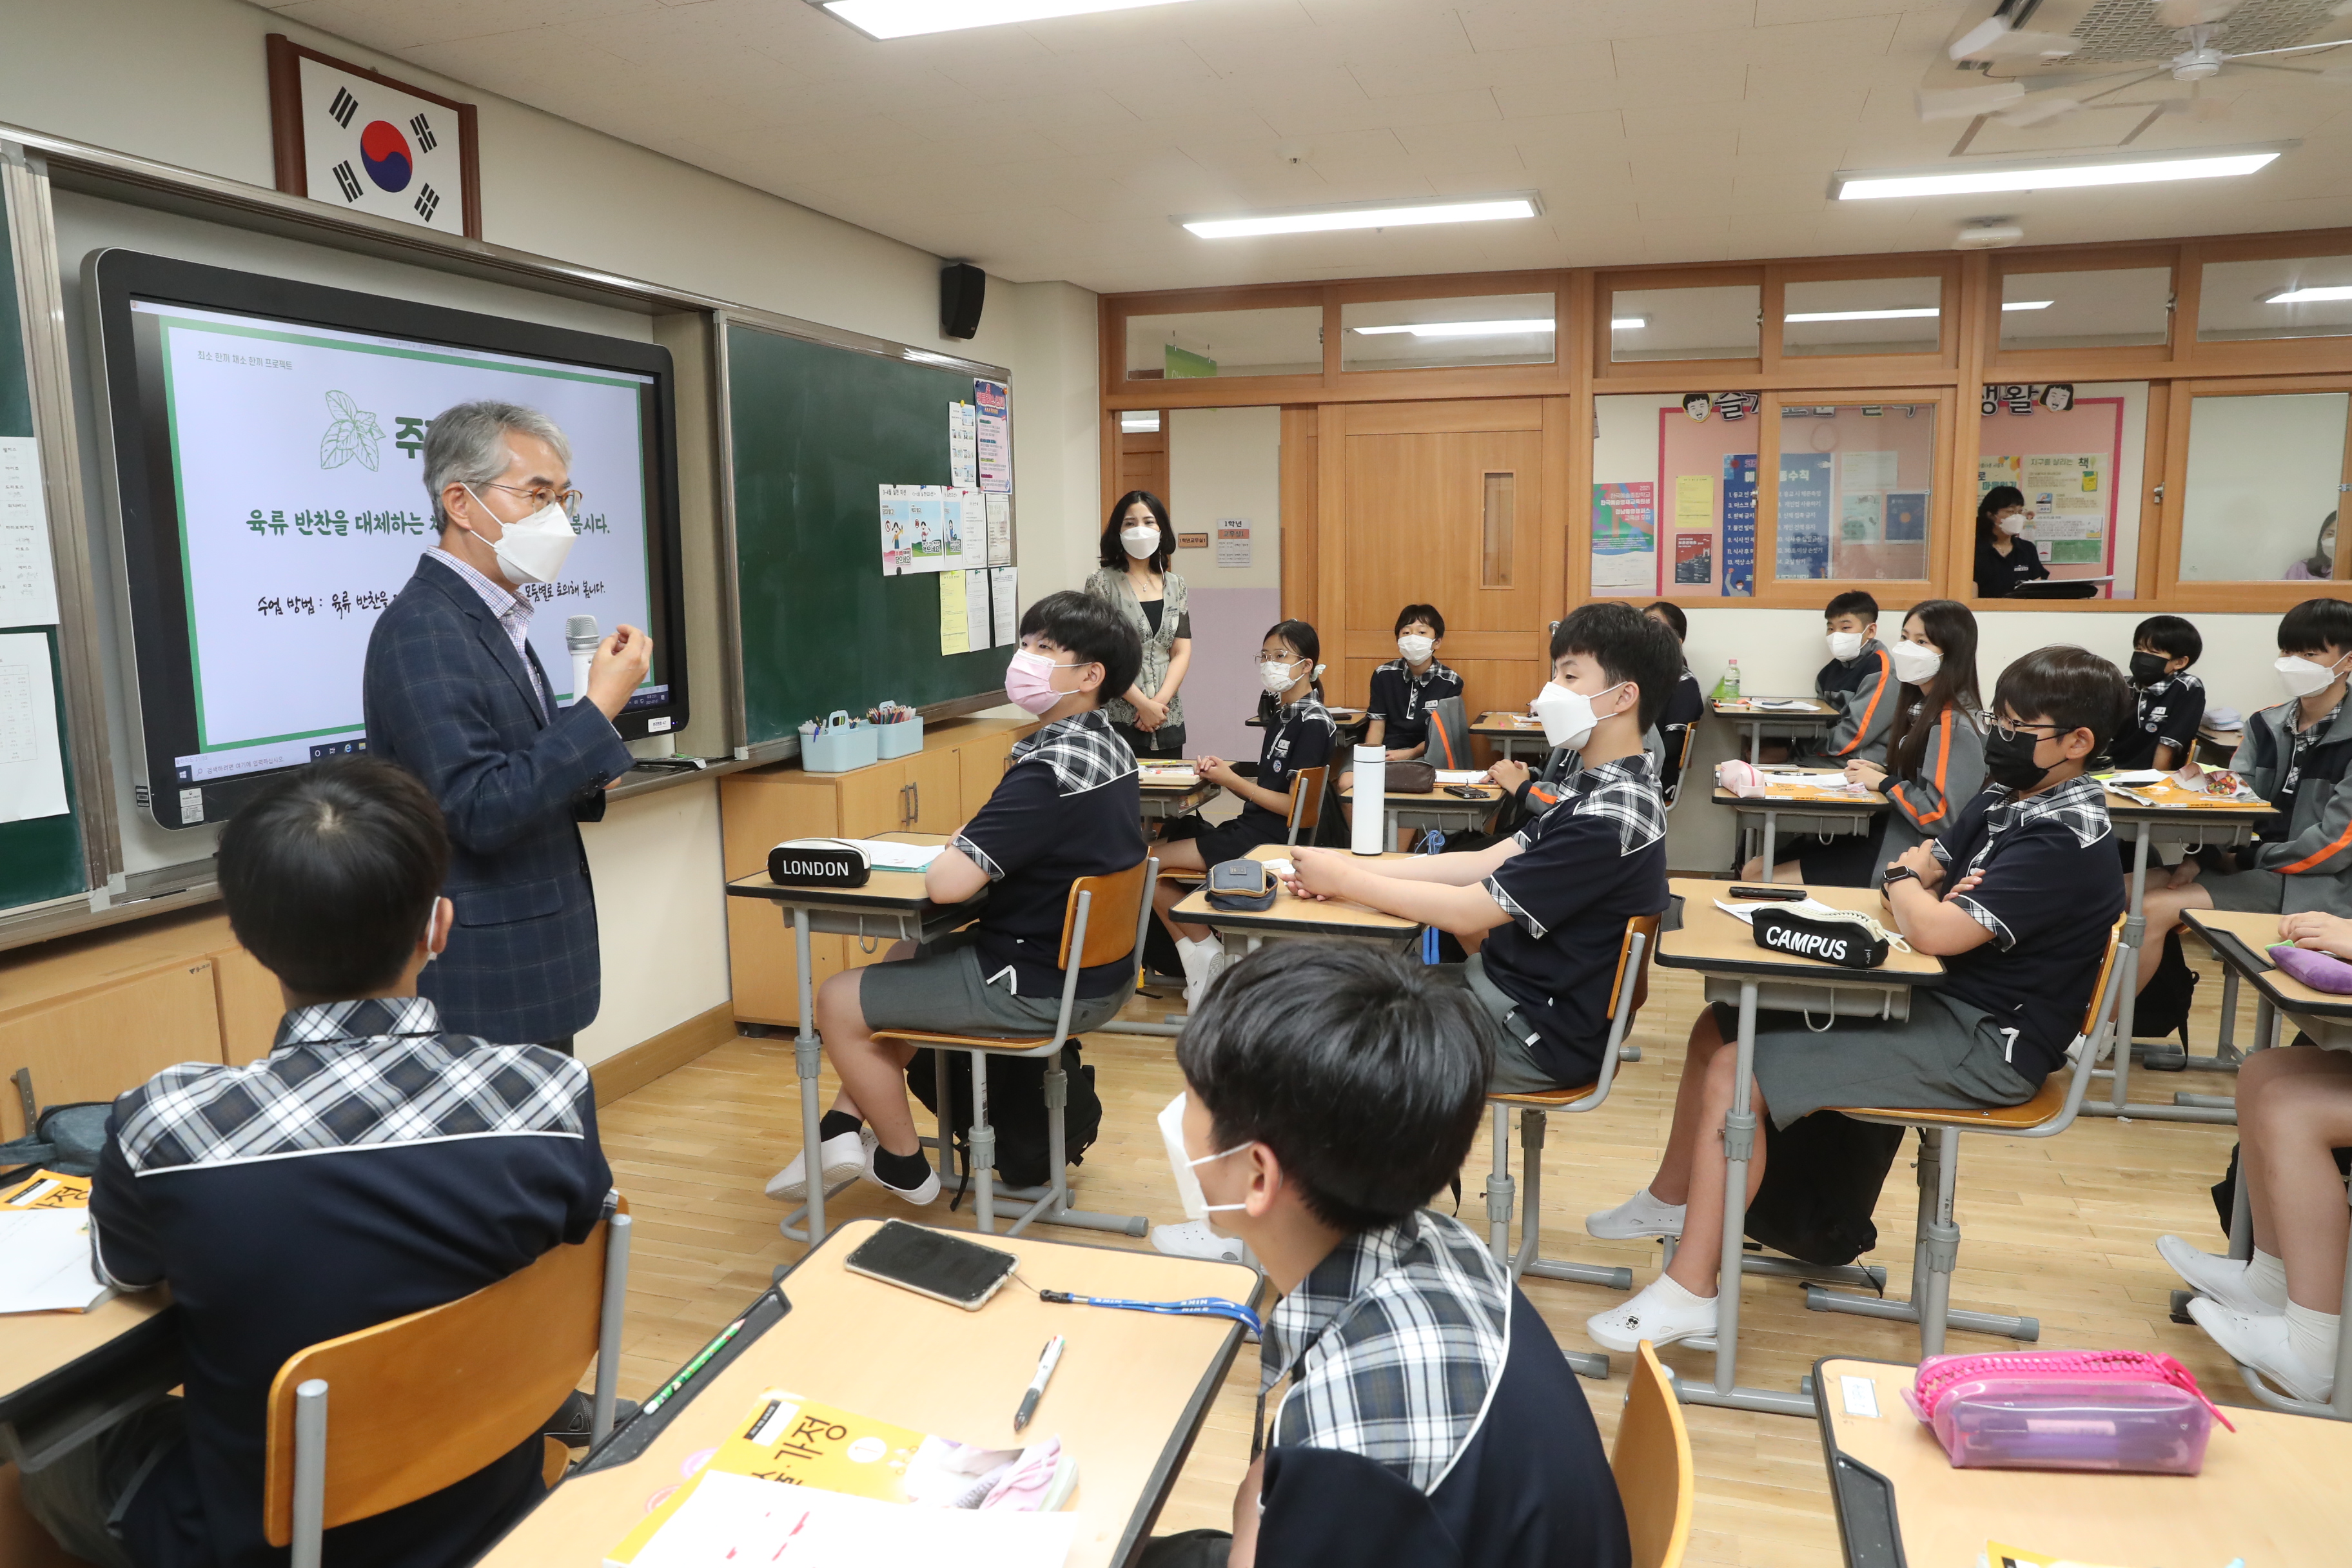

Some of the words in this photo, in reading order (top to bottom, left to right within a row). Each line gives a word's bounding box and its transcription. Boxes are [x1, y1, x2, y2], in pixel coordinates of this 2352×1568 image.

[198, 351, 213, 361] 최소
[215, 353, 230, 363] 한끼
[232, 355, 247, 365] 채소
[249, 357, 263, 367] 한끼
[265, 358, 293, 370] 프로젝트
[395, 416, 433, 458] 주
[2078, 457, 2089, 469] 책
[246, 509, 289, 536] 육류
[295, 509, 349, 536] 반찬을
[355, 510, 424, 535] 대체하는
[258, 596, 283, 616] 수업
[287, 596, 315, 616] 방법
[332, 591, 351, 620] 육류
[356, 591, 389, 610] 반찬을
[525, 583, 554, 603] 모둠별로
[557, 580, 580, 596] 토의해
[583, 580, 606, 598] 봅니다.
[207, 765, 234, 774] 검색하려면
[253, 756, 284, 767] 입력하십시오
[783, 860, 849, 877] LONDON
[1766, 926, 1848, 961] CAMPUS
